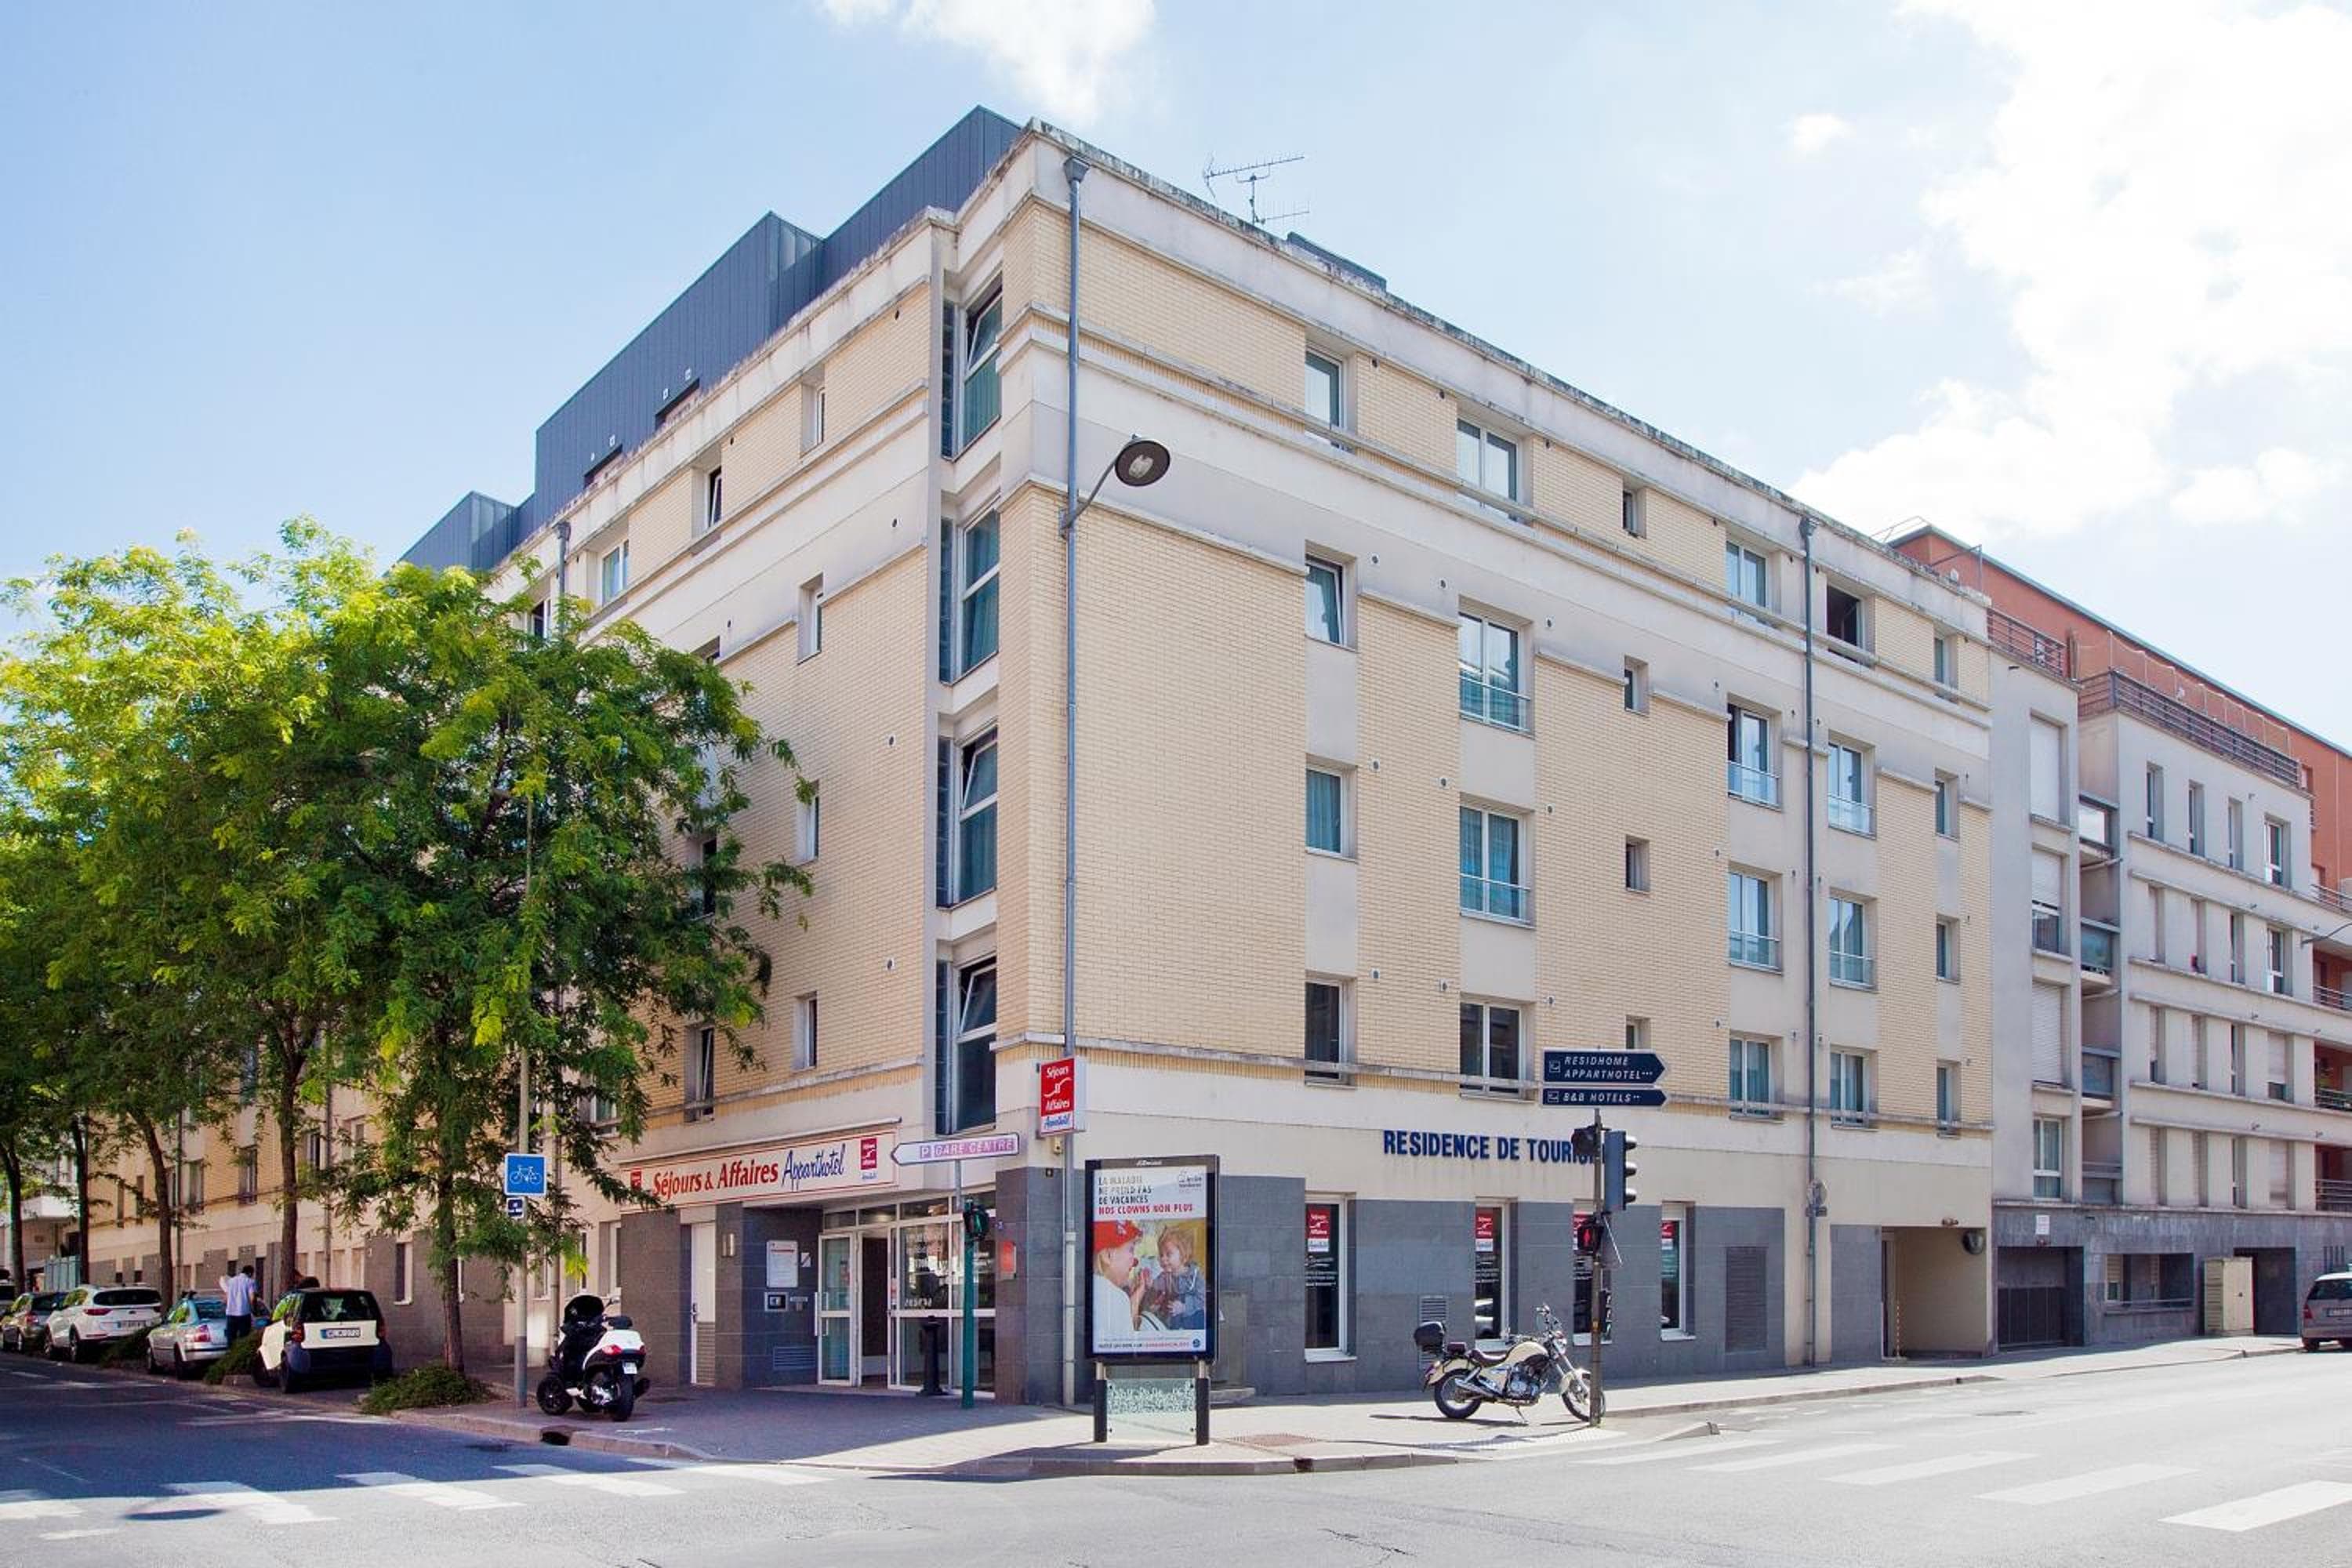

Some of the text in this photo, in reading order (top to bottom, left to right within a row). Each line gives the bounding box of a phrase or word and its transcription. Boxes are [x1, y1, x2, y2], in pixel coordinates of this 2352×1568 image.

[1564, 1056, 1629, 1066] RESIDHOME
[1564, 1069, 1641, 1080] APPARTHOTEL
[1563, 1092, 1632, 1102] B&B HOTELS
[935, 1144, 965, 1156] GARE
[968, 1140, 1012, 1153] CENTRE
[1383, 1130, 1605, 1165] RESIDENCE DE TOUR
[653, 1171, 702, 1201] Séjours
[705, 1171, 713, 1191] &
[717, 1158, 779, 1189] Affaires
[1098, 1195, 1149, 1205] DE VACANCES
[1098, 1203, 1192, 1214] NOS CLOWNS NON PLUS
